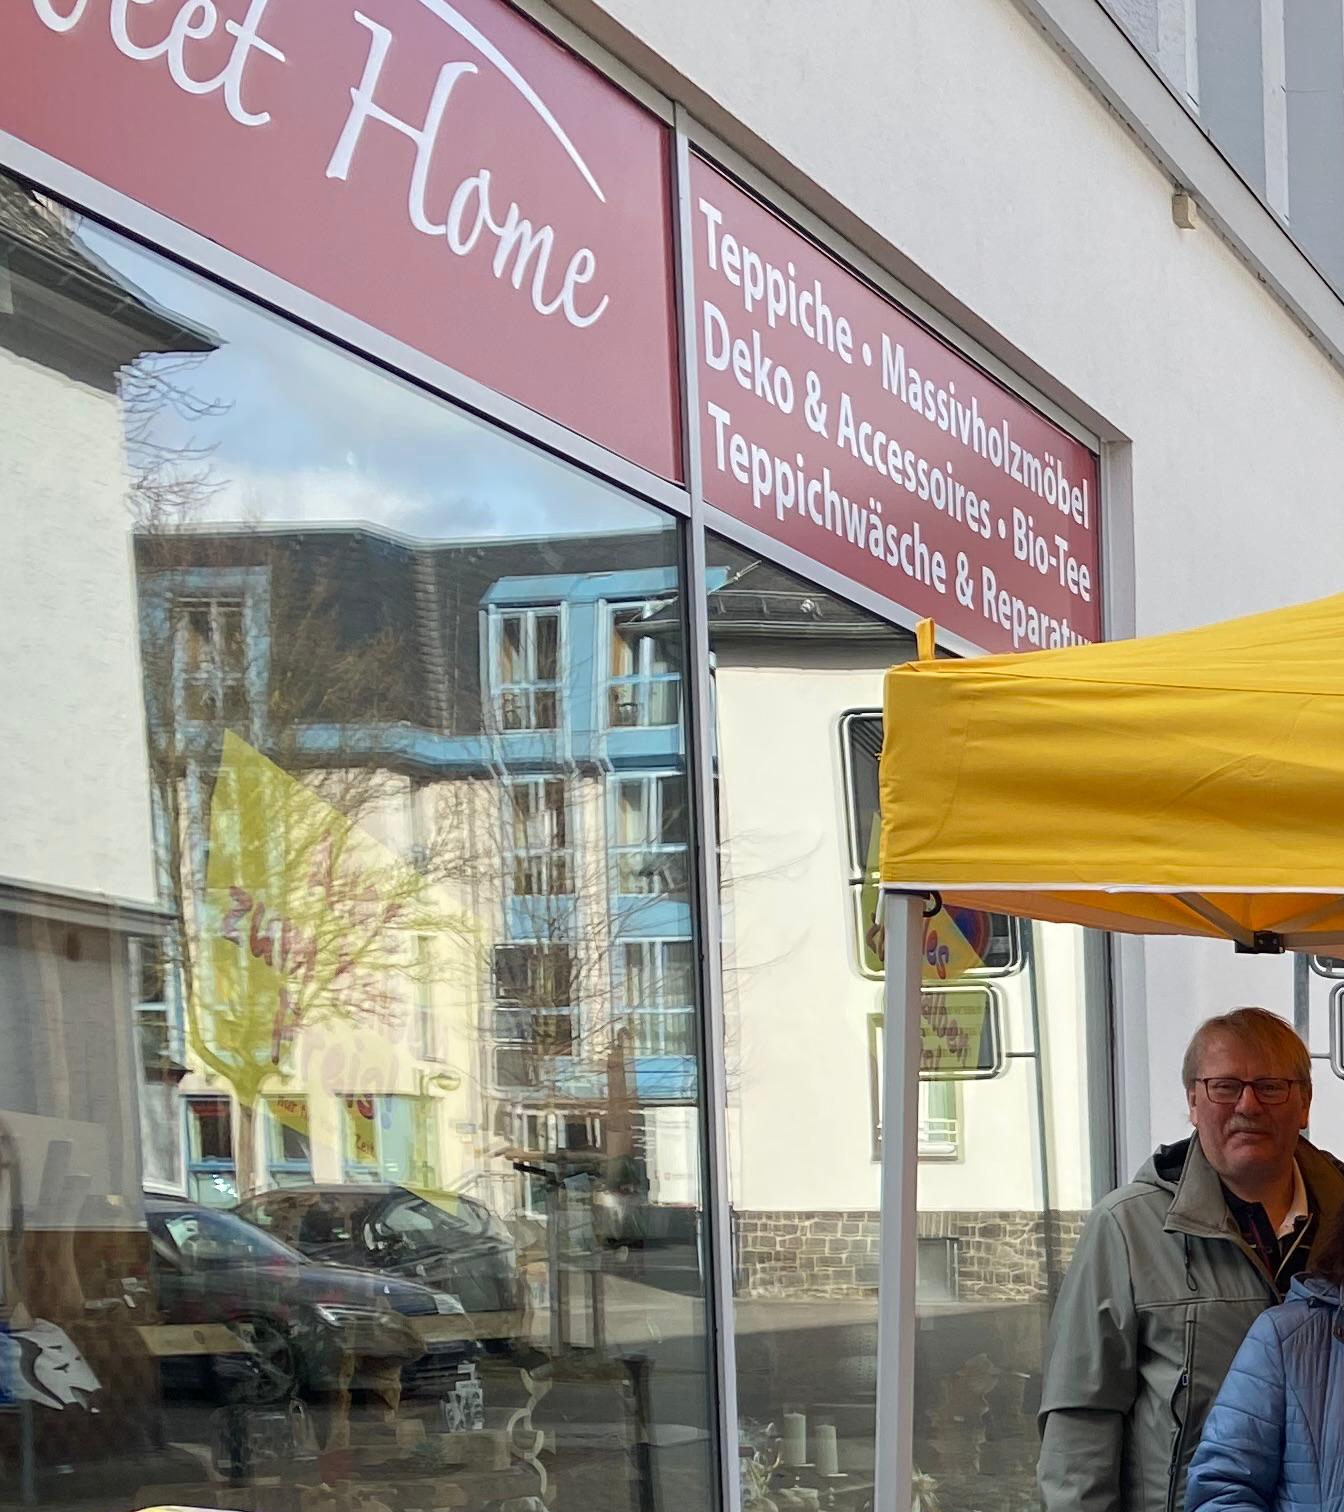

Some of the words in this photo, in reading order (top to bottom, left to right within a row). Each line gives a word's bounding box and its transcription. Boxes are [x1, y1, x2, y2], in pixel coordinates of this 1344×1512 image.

[326, 9, 609, 328] Home
[699, 197, 853, 365] Teppiche
[880, 332, 1089, 530] Massivholzmöbel
[703, 300, 793, 414] Deko
[804, 371, 829, 440] &
[837, 391, 991, 540] Accessoires
[1012, 518, 1091, 603] Bio-Tee
[706, 400, 948, 595] Teppichwäsche
[954, 552, 975, 608] &
[982, 565, 1092, 649] Reparatu
